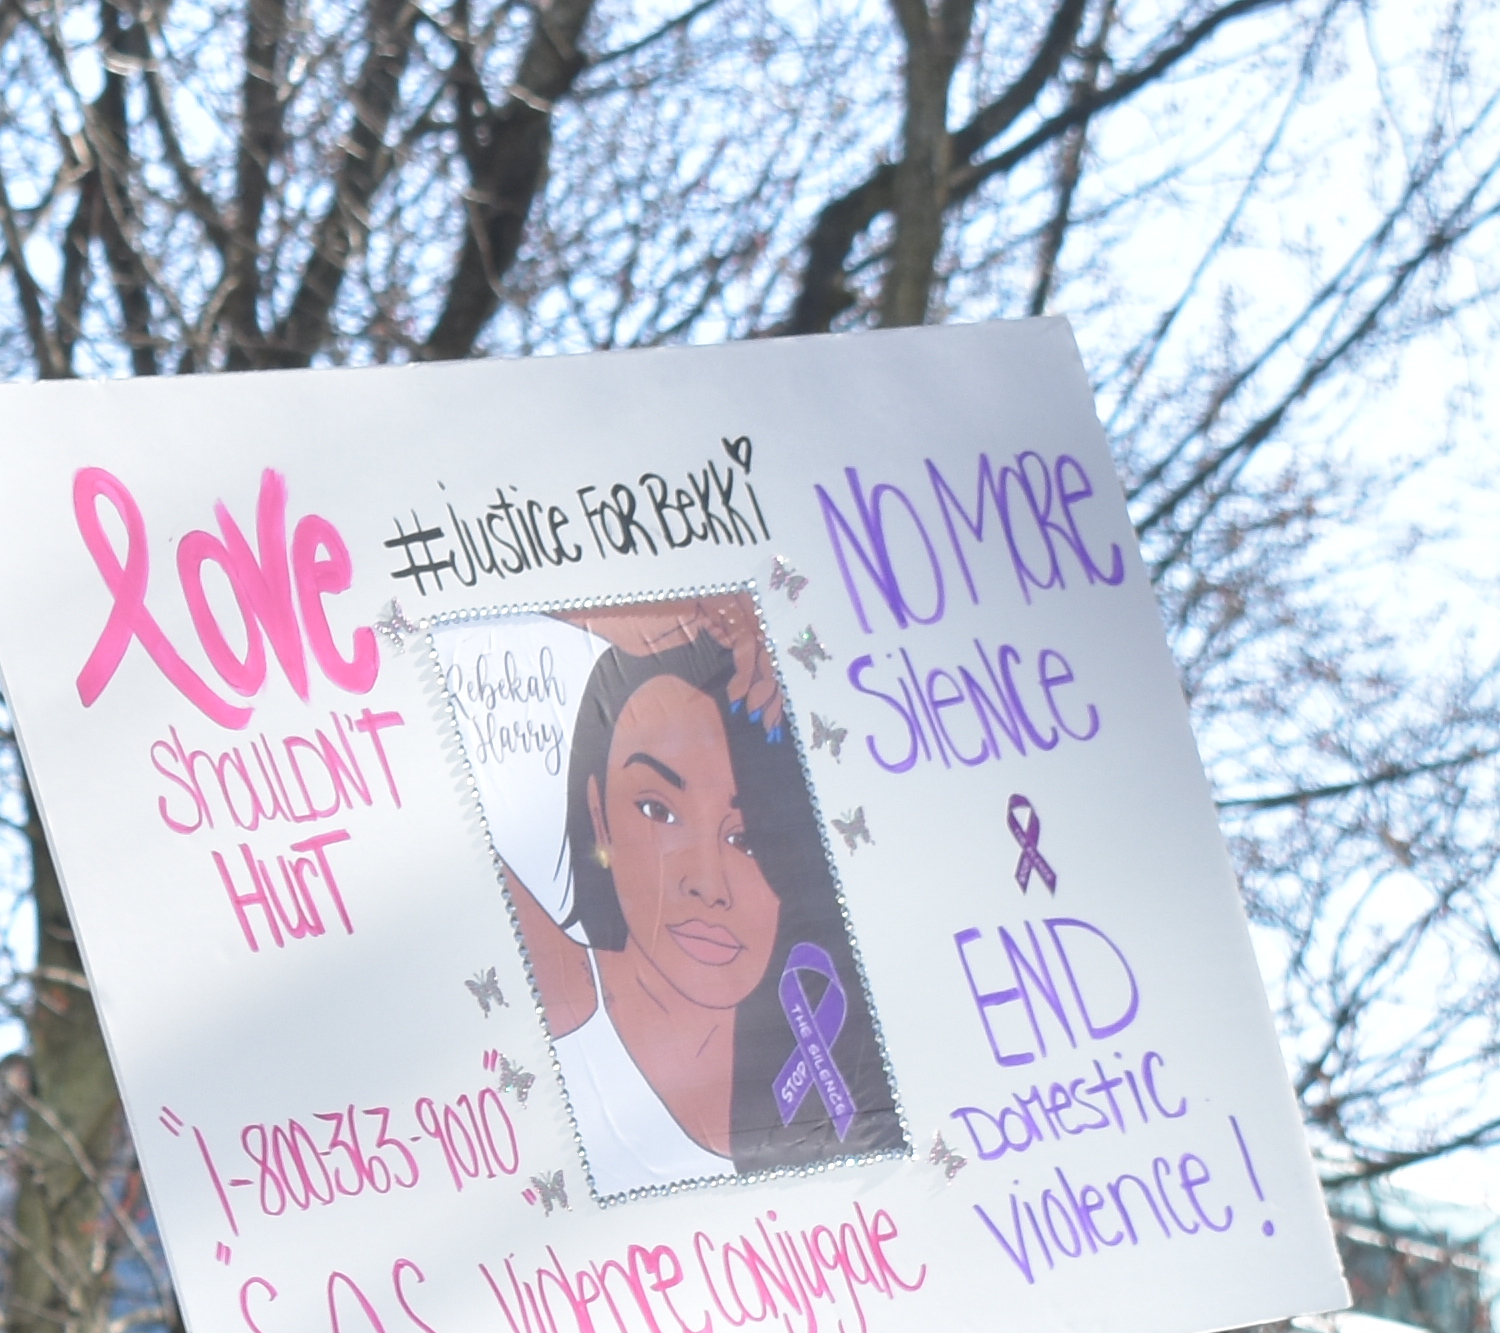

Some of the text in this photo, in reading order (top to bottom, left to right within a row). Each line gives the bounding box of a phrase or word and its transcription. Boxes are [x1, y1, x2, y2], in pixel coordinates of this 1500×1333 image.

[813, 464, 946, 636] NO
[446, 646, 567, 720] Rebekah
[471, 712, 565, 777] Harry
[953, 916, 1141, 1068] END
[780, 1060, 808, 1104] STOP
[790, 1003, 848, 1117] THE SILENCE
